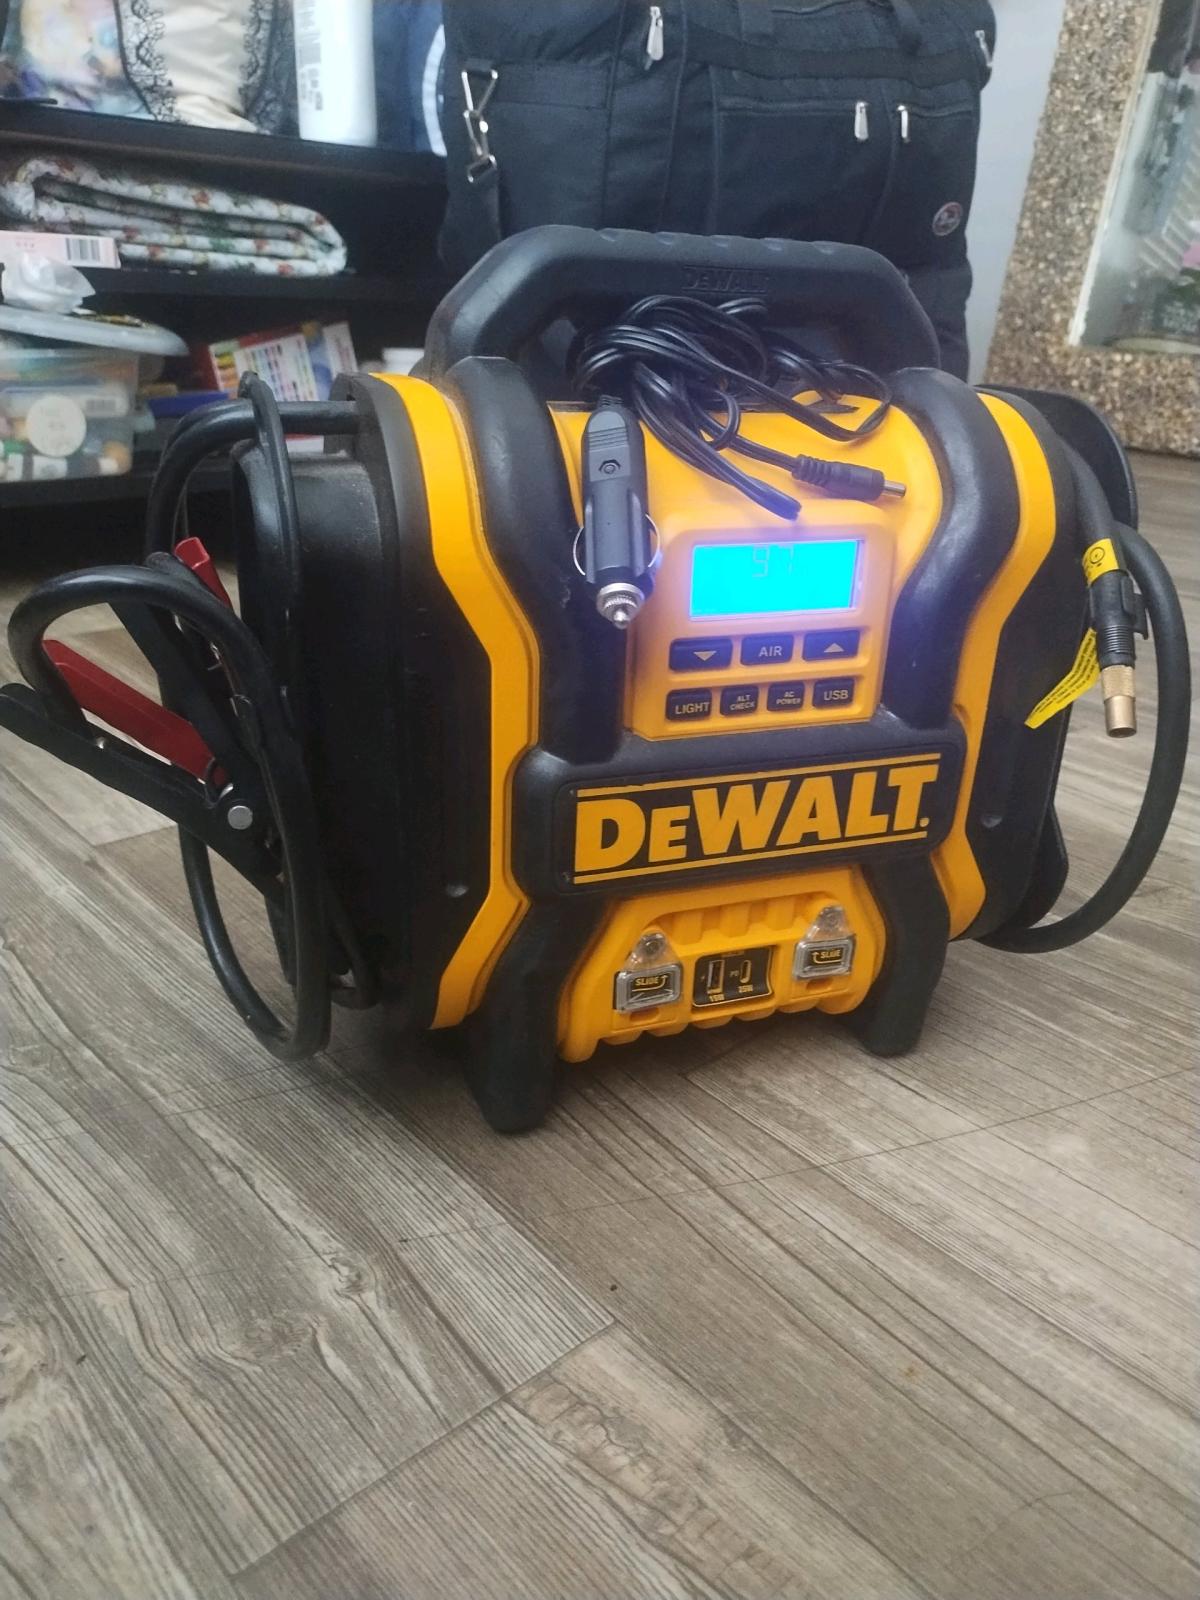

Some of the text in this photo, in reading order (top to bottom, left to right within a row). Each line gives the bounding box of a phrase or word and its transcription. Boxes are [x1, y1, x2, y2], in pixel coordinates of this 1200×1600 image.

[758, 645, 782, 657] AIR
[736, 694, 751, 703] ALT
[783, 690, 795, 698] AC
[823, 689, 849, 701] USB
[729, 700, 755, 711] CHECK
[775, 696, 801, 705] POWER
[674, 701, 710, 715] LIGHT
[820, 949, 841, 960] SLIDE
[635, 975, 659, 987] SLIDE
